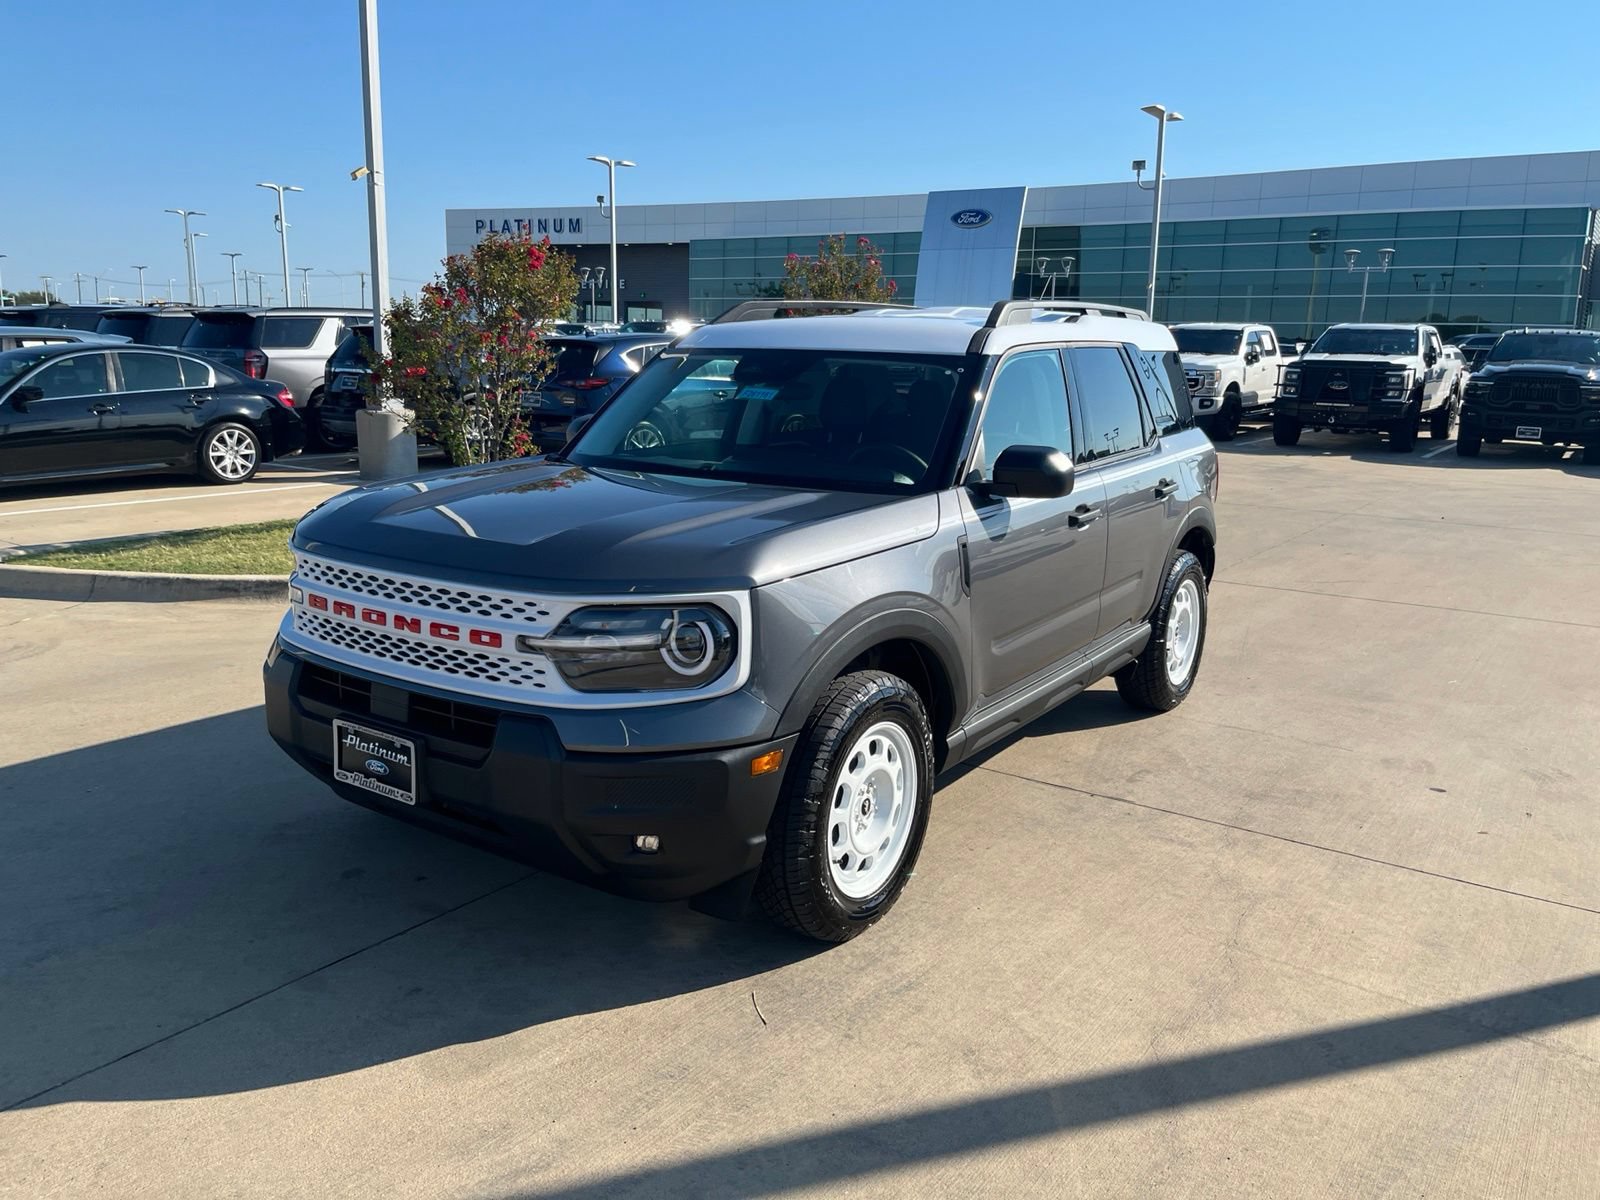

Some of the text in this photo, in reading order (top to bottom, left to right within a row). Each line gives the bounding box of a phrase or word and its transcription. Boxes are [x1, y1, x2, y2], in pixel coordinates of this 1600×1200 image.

[475, 218, 582, 235] PLATINUM
[957, 212, 982, 224] Ford
[308, 593, 502, 649] BRONCO
[342, 734, 411, 767] Platinum
[369, 761, 385, 774] Ford
[352, 773, 399, 798] Platinum
